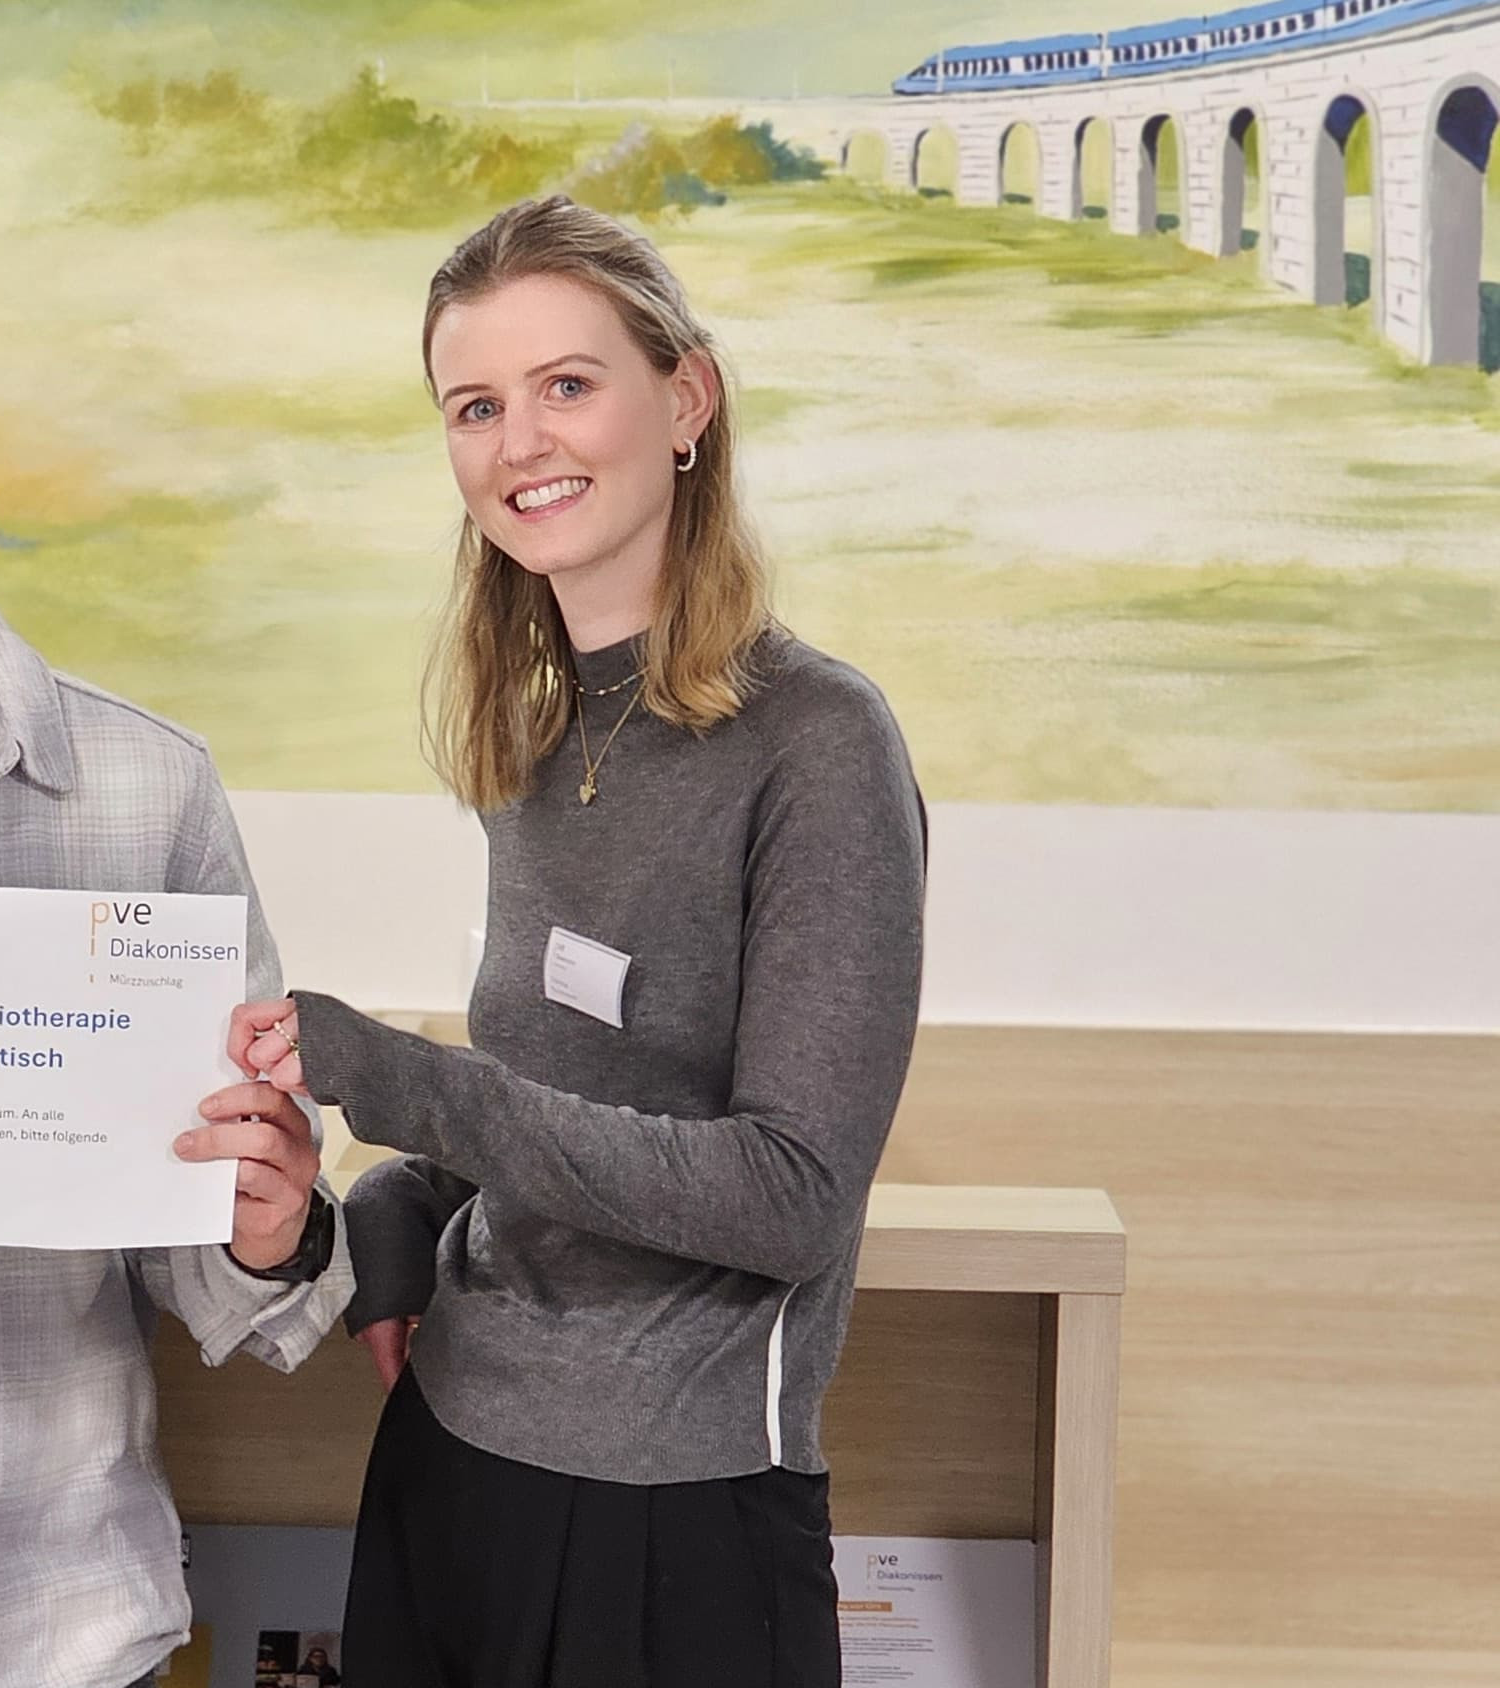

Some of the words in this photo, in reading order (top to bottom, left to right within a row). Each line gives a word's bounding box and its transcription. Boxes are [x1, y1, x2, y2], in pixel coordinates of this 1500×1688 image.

[91, 901, 152, 936] pve
[110, 938, 239, 960] Diakonissen
[109, 973, 183, 989] Mürzzuschlag
[21, 1109, 39, 1121] An
[41, 1109, 65, 1121] alle
[20, 1128, 50, 1141] bitte
[52, 1130, 108, 1145] folgende
[867, 1554, 898, 1571] pve
